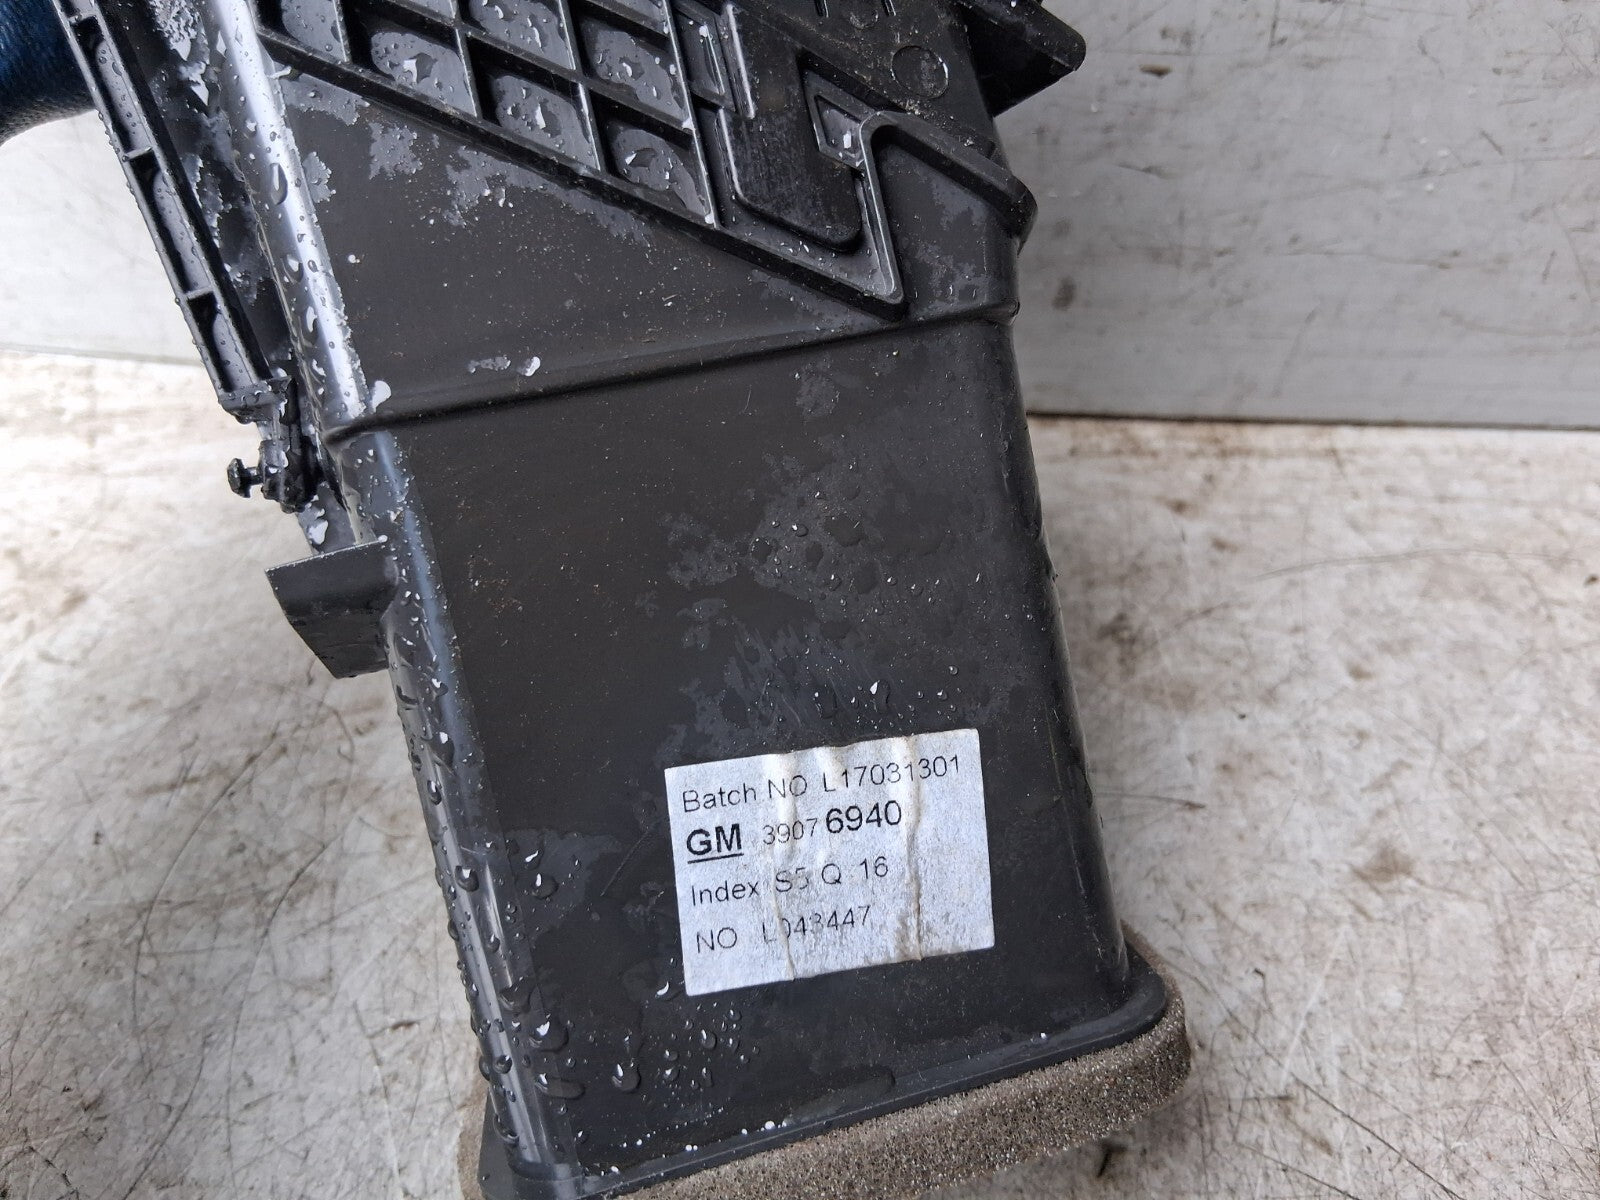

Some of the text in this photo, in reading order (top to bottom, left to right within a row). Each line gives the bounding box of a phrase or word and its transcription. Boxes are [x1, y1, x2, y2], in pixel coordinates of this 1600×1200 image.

[682, 755, 960, 813] Batch NO L17031301
[686, 823, 743, 856] GM
[690, 879, 759, 906] Index
[821, 863, 842, 886] Q
[860, 856, 889, 880] 16
[696, 926, 738, 953] NO
